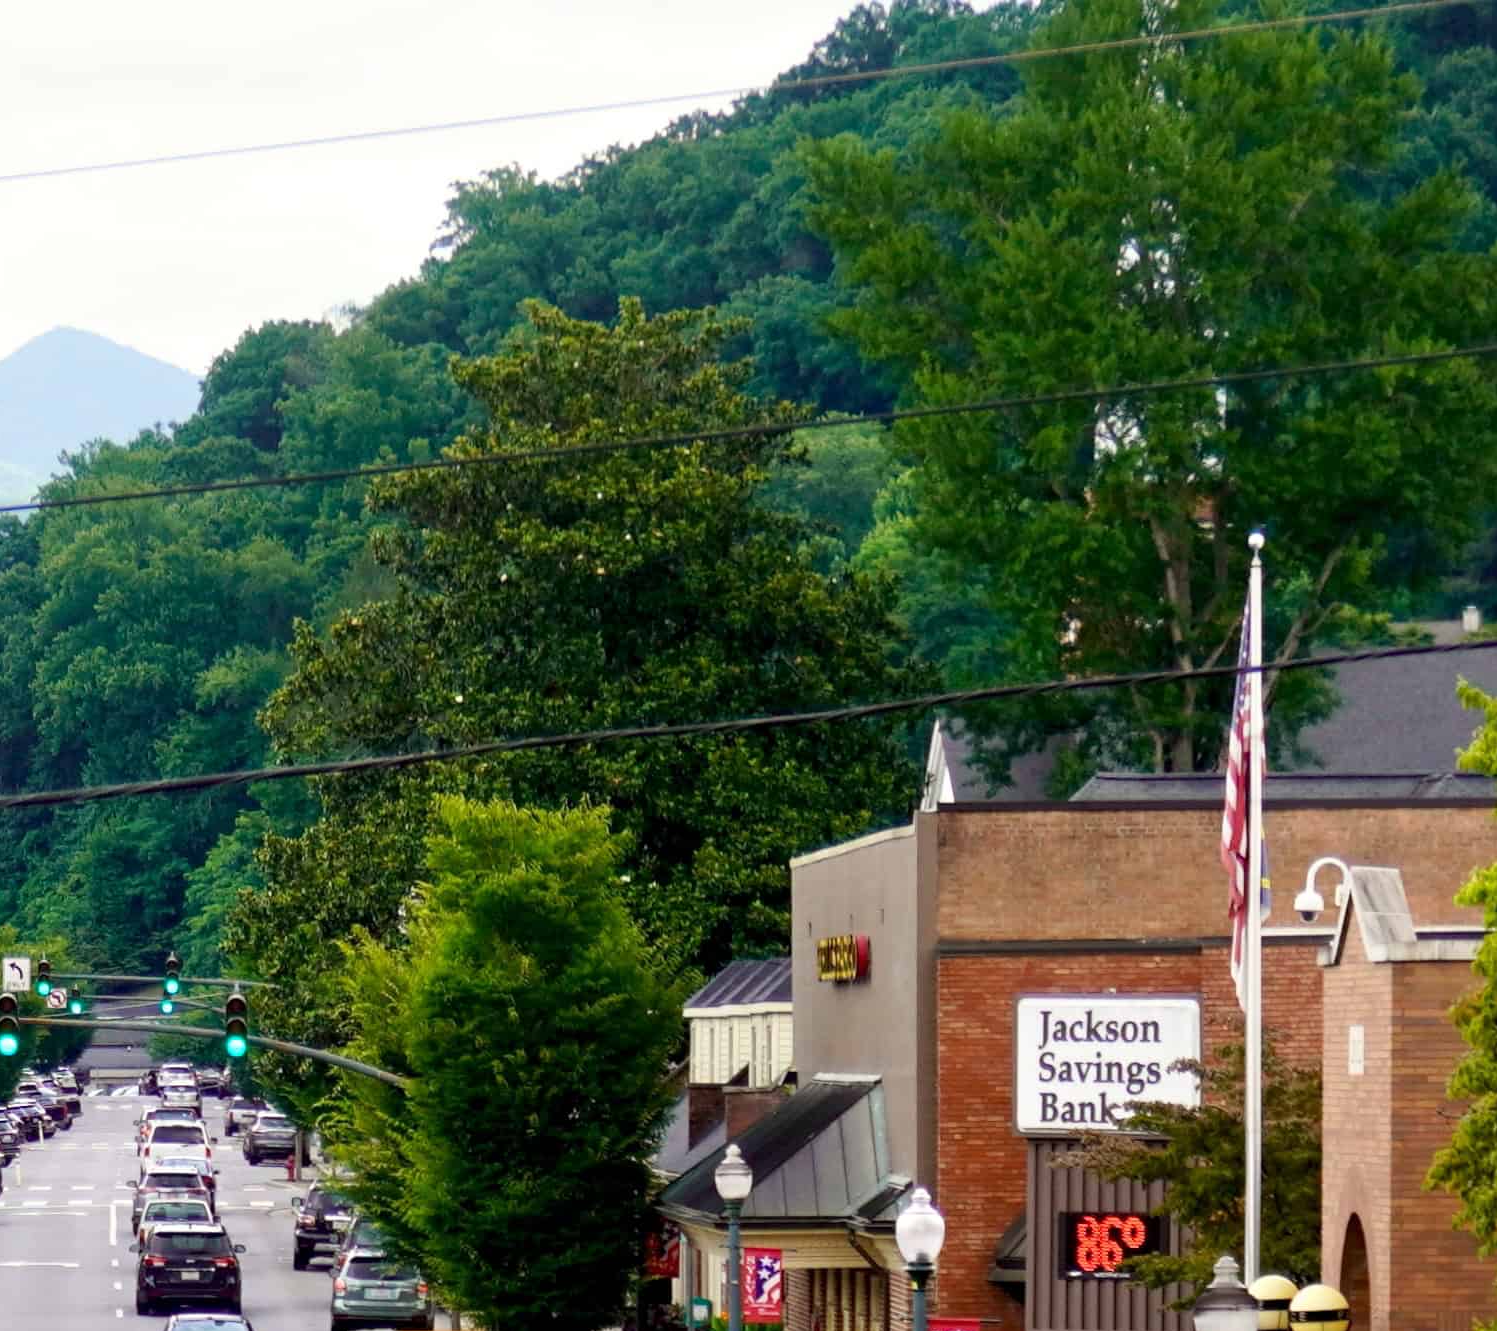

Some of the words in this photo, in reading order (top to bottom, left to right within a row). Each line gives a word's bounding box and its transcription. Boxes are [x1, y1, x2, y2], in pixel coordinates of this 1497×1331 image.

[1038, 1009, 1162, 1050] Jackson
[1038, 1051, 1162, 1095] Savings
[1039, 1092, 1125, 1124] Bank
